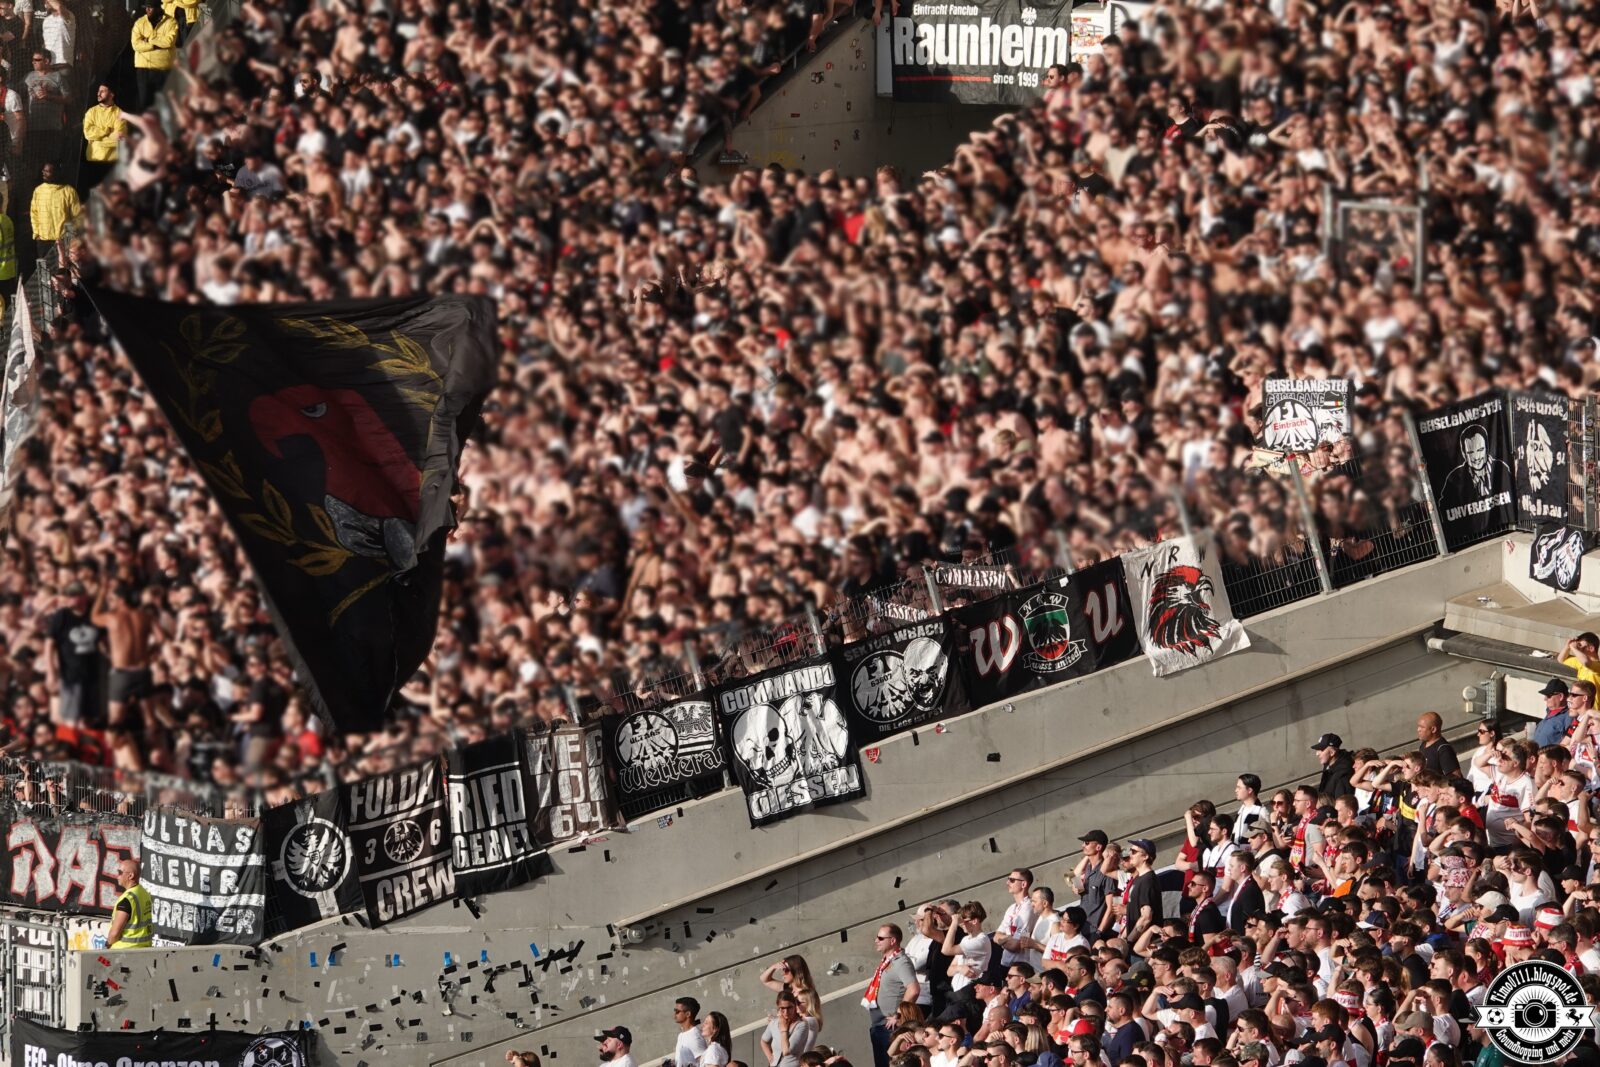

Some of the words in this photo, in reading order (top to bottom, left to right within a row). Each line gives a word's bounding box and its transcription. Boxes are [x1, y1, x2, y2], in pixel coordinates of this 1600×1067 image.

[913, 4, 948, 17] Eintracht
[949, 5, 979, 17] Fanclub
[894, 17, 1067, 69] Raunheim
[993, 74, 1014, 85] since
[1265, 379, 1348, 393] GEISELGANGSTER
[1273, 419, 1309, 431] Eintracht
[1420, 398, 1503, 434] GEISELGANGSTER
[1446, 491, 1512, 521] UNVERGESSEN
[935, 566, 1006, 589] COMMANDO
[969, 614, 1022, 678] W
[720, 662, 836, 716] COMMANDO
[878, 724, 892, 732] DIE
[350, 759, 437, 823] FULDA
[449, 769, 527, 834] RIED
[749, 764, 861, 820] GIESSEN
[143, 810, 255, 852] ULTRAS
[430, 818, 442, 846] 6
[549, 801, 604, 838] 64
[364, 838, 377, 865] 3
[150, 853, 240, 894] NEVER
[376, 859, 456, 922] CREW
